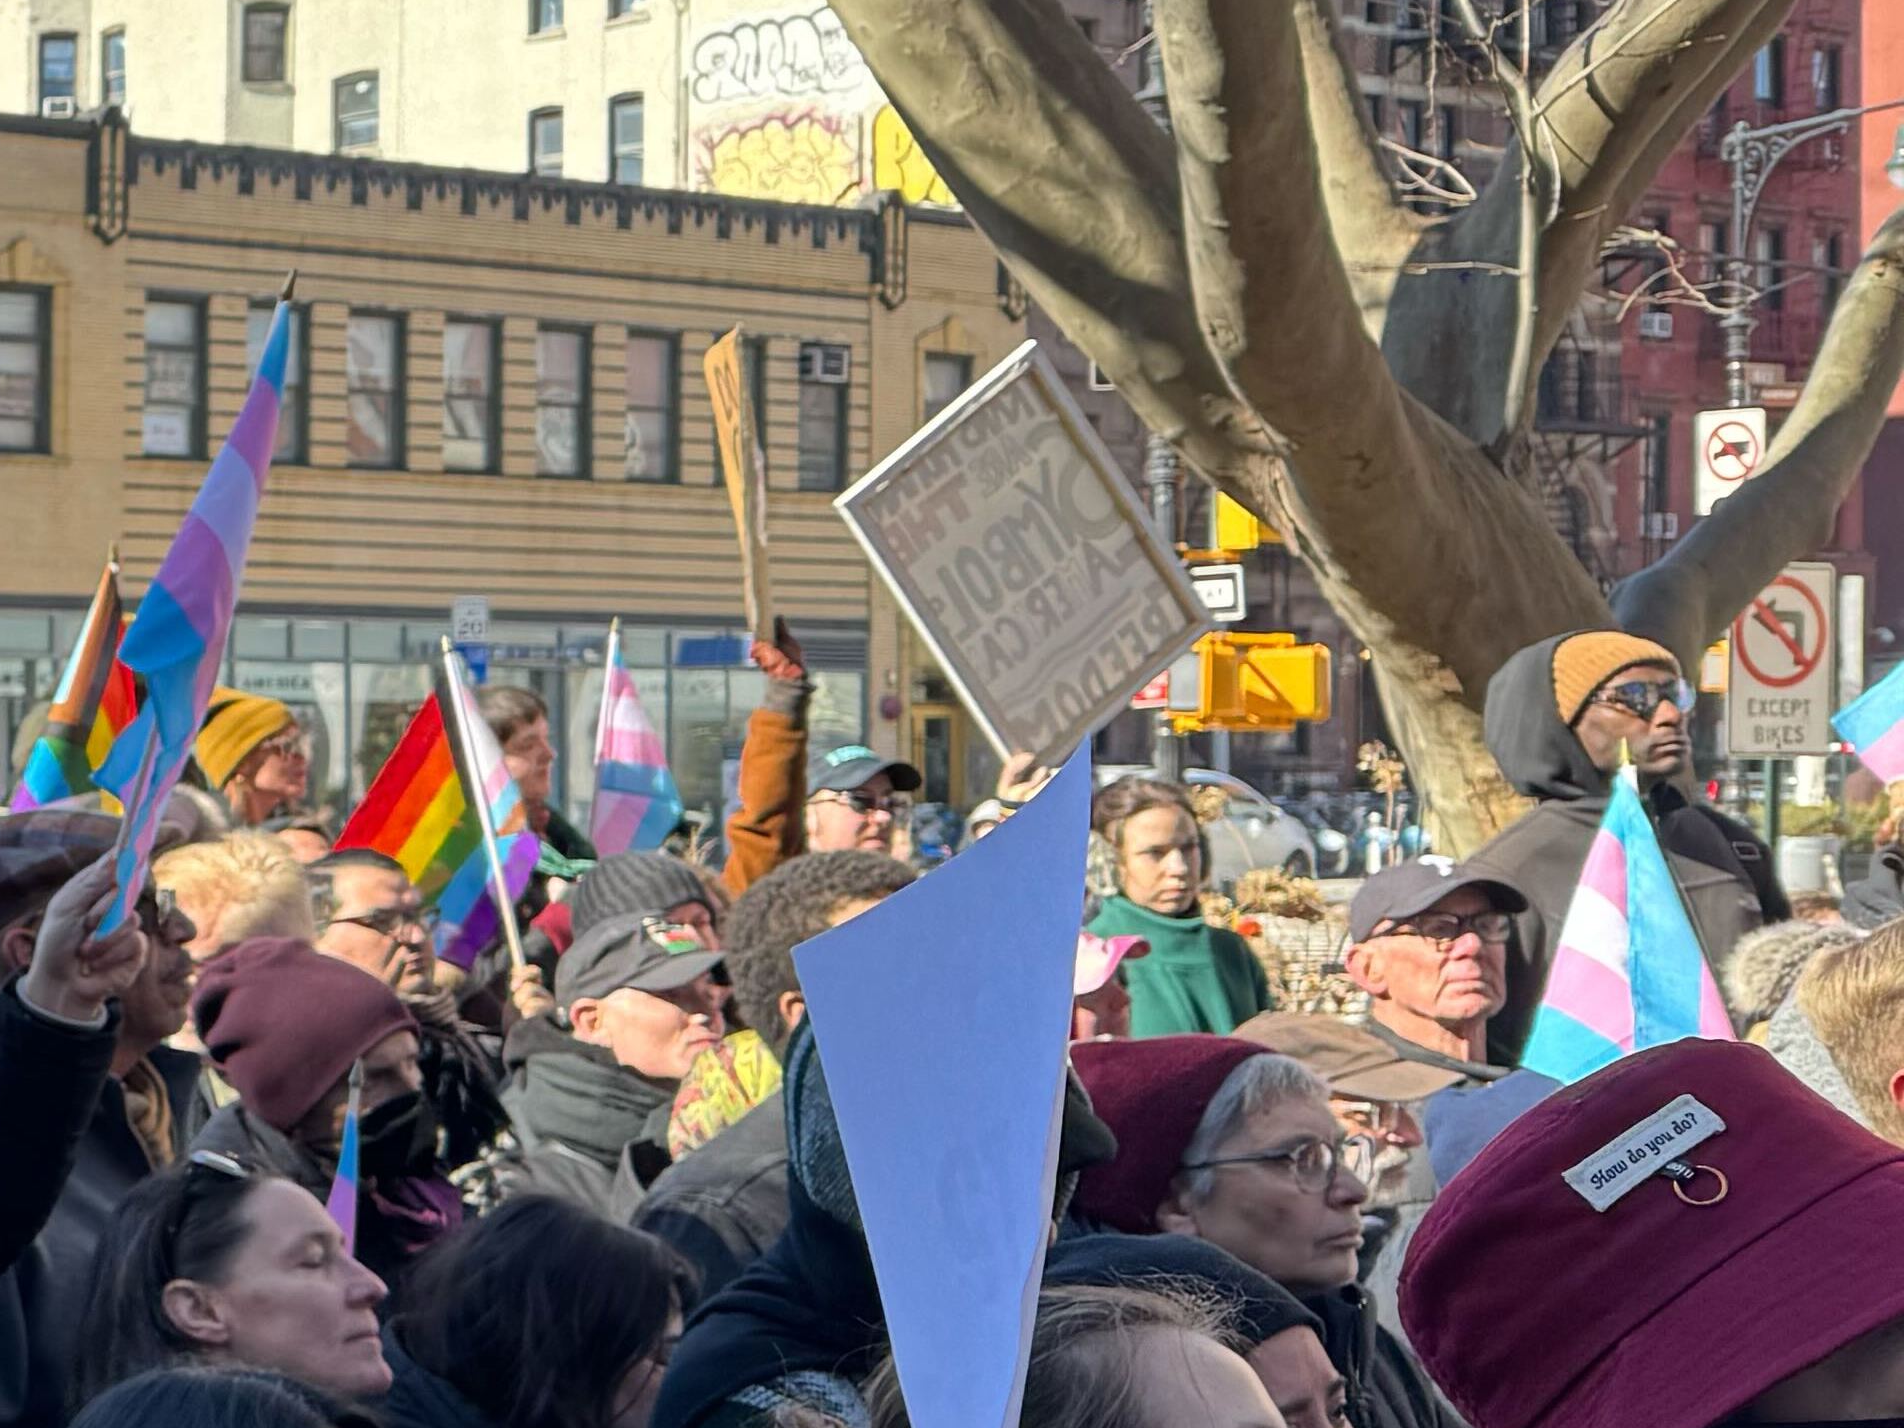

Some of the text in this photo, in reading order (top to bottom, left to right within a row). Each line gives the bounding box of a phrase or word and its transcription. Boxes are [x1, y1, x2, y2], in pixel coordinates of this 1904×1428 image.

[1747, 697, 1811, 719] EXCEPT
[1753, 725, 1805, 746] BIKES
[1590, 1112, 1699, 1191] How do you do?
